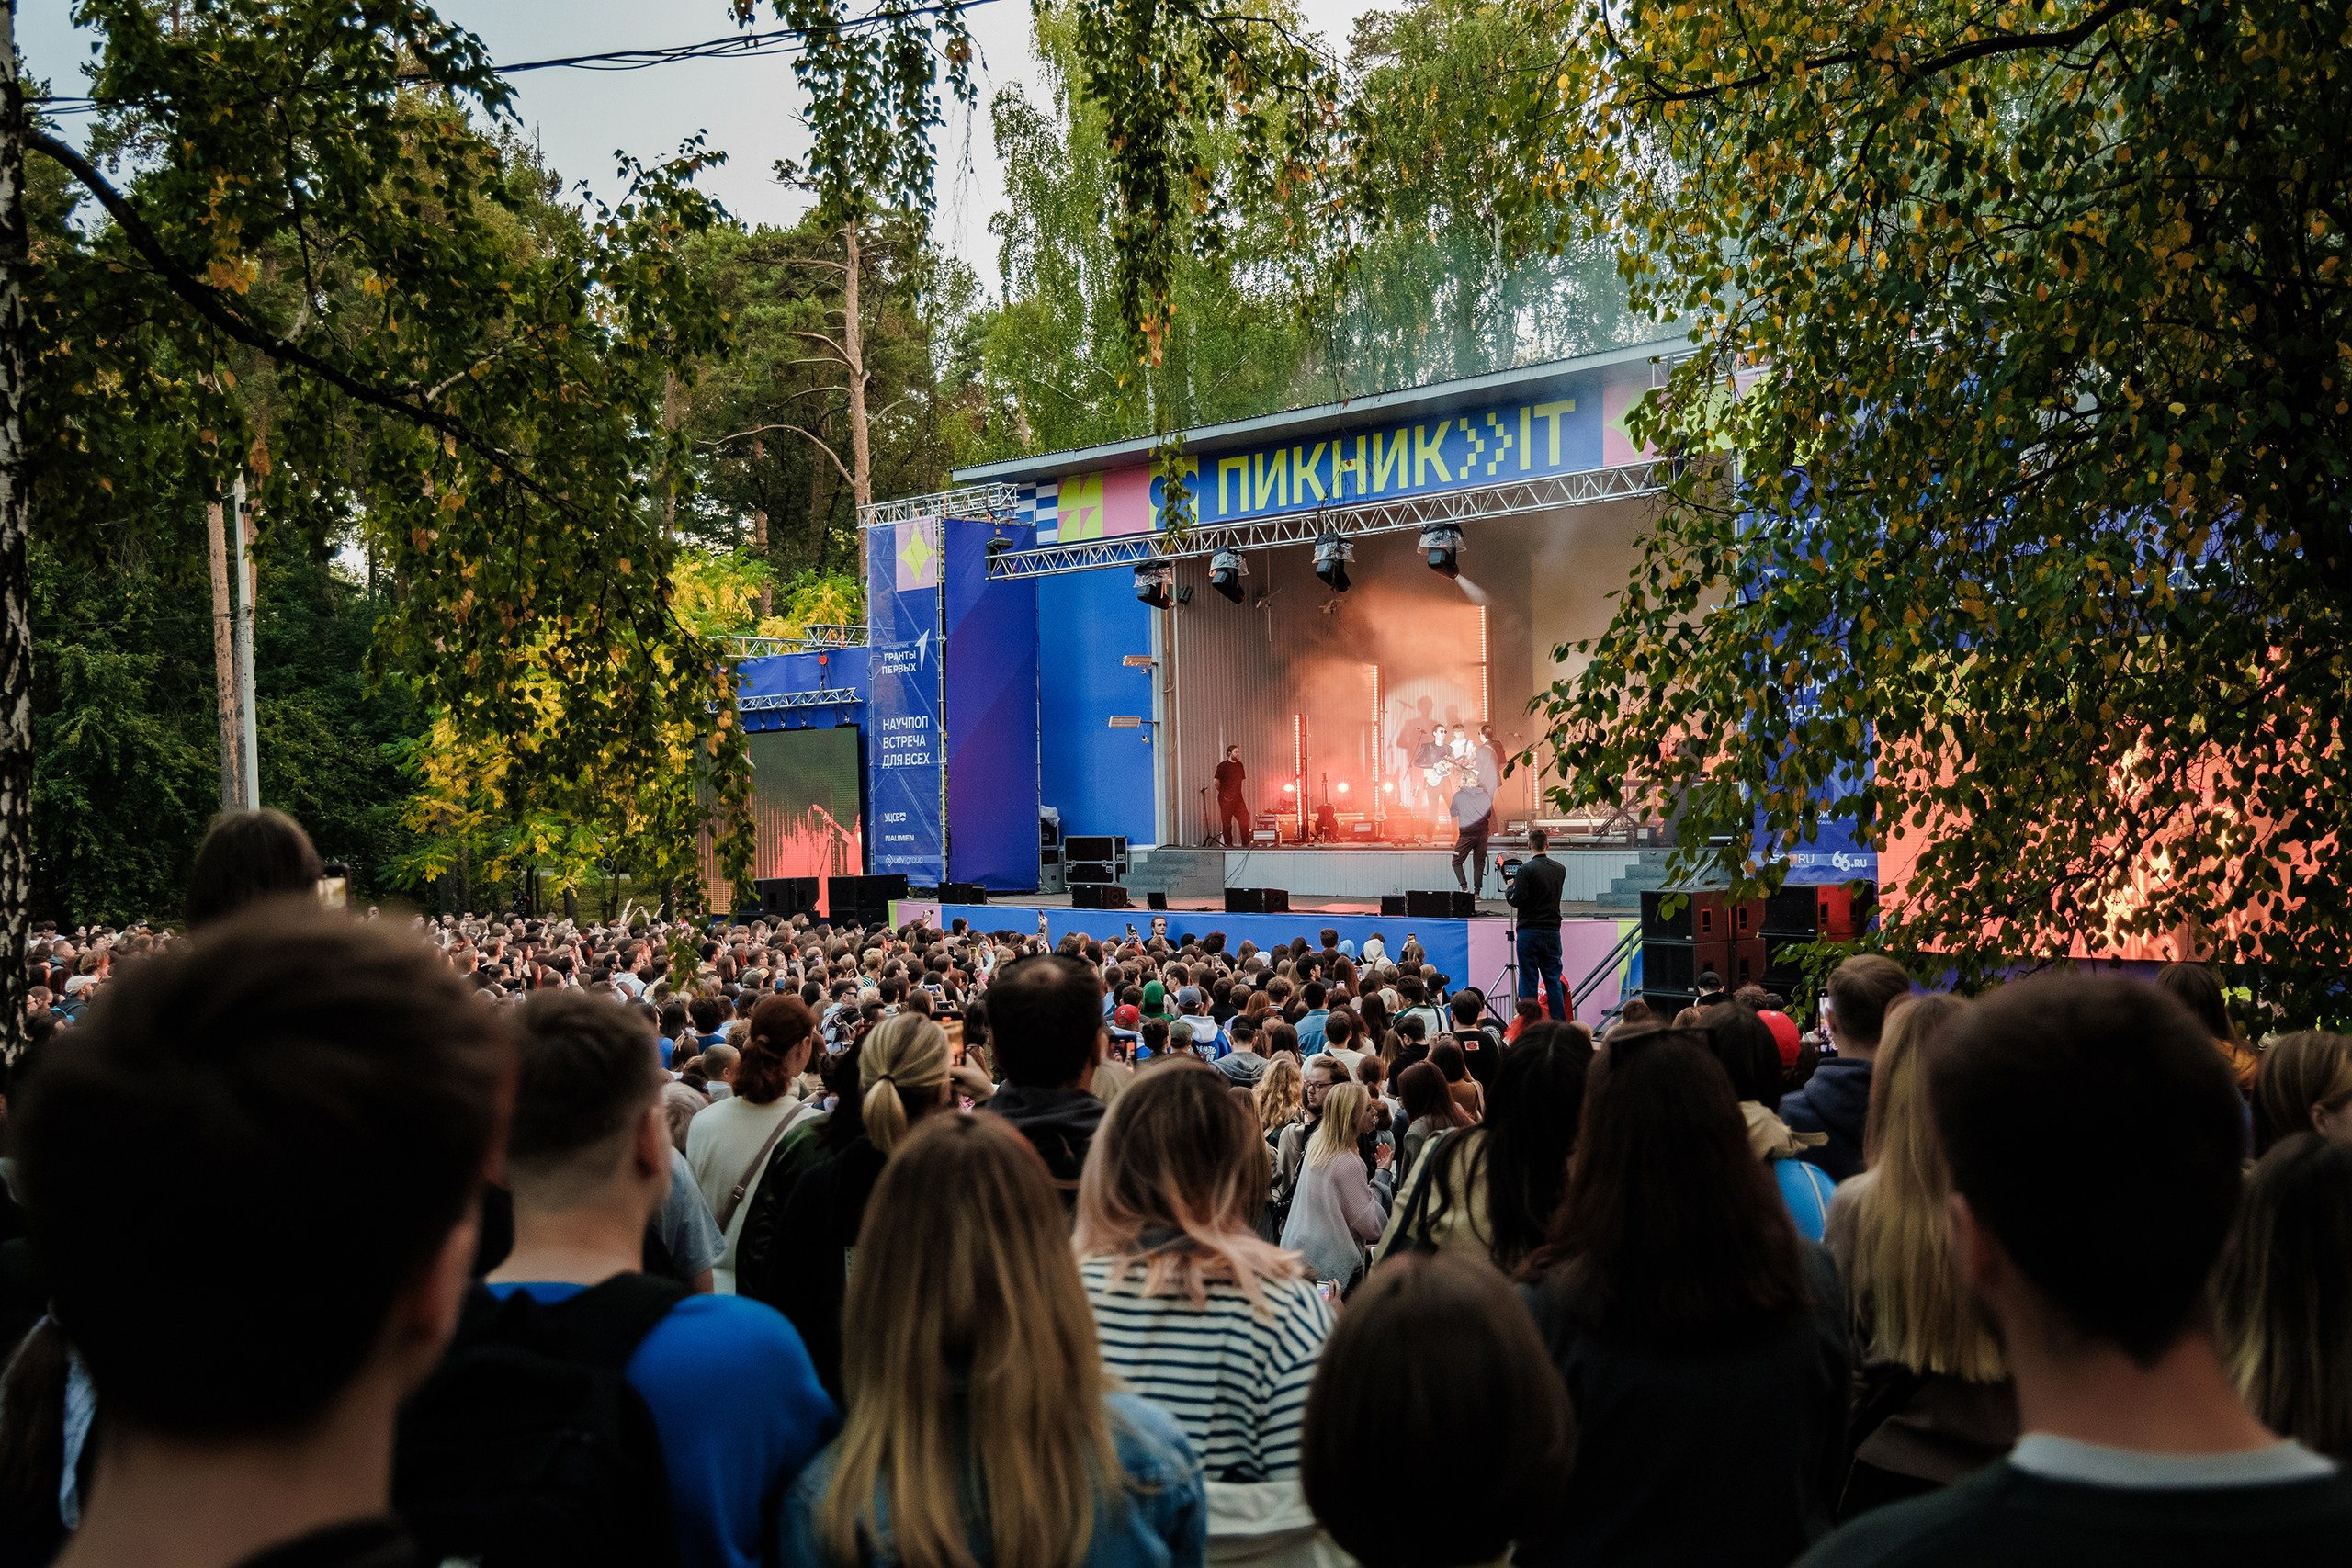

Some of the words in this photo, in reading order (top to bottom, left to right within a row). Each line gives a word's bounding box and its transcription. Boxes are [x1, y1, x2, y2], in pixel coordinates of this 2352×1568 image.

[1218, 420, 1453, 515] ПИКНИК
[1519, 399, 1577, 470] IT
[884, 650, 917, 661] ГРАНТЫ
[882, 663, 917, 674] ПЕРВЫХ
[883, 716, 929, 731] НАУЧПОП
[883, 734, 926, 749] ВСТРЕЧА
[882, 753, 903, 769] ДЛЯ
[904, 752, 930, 765] ВСЕХ
[885, 834, 915, 842] NAUMEN
